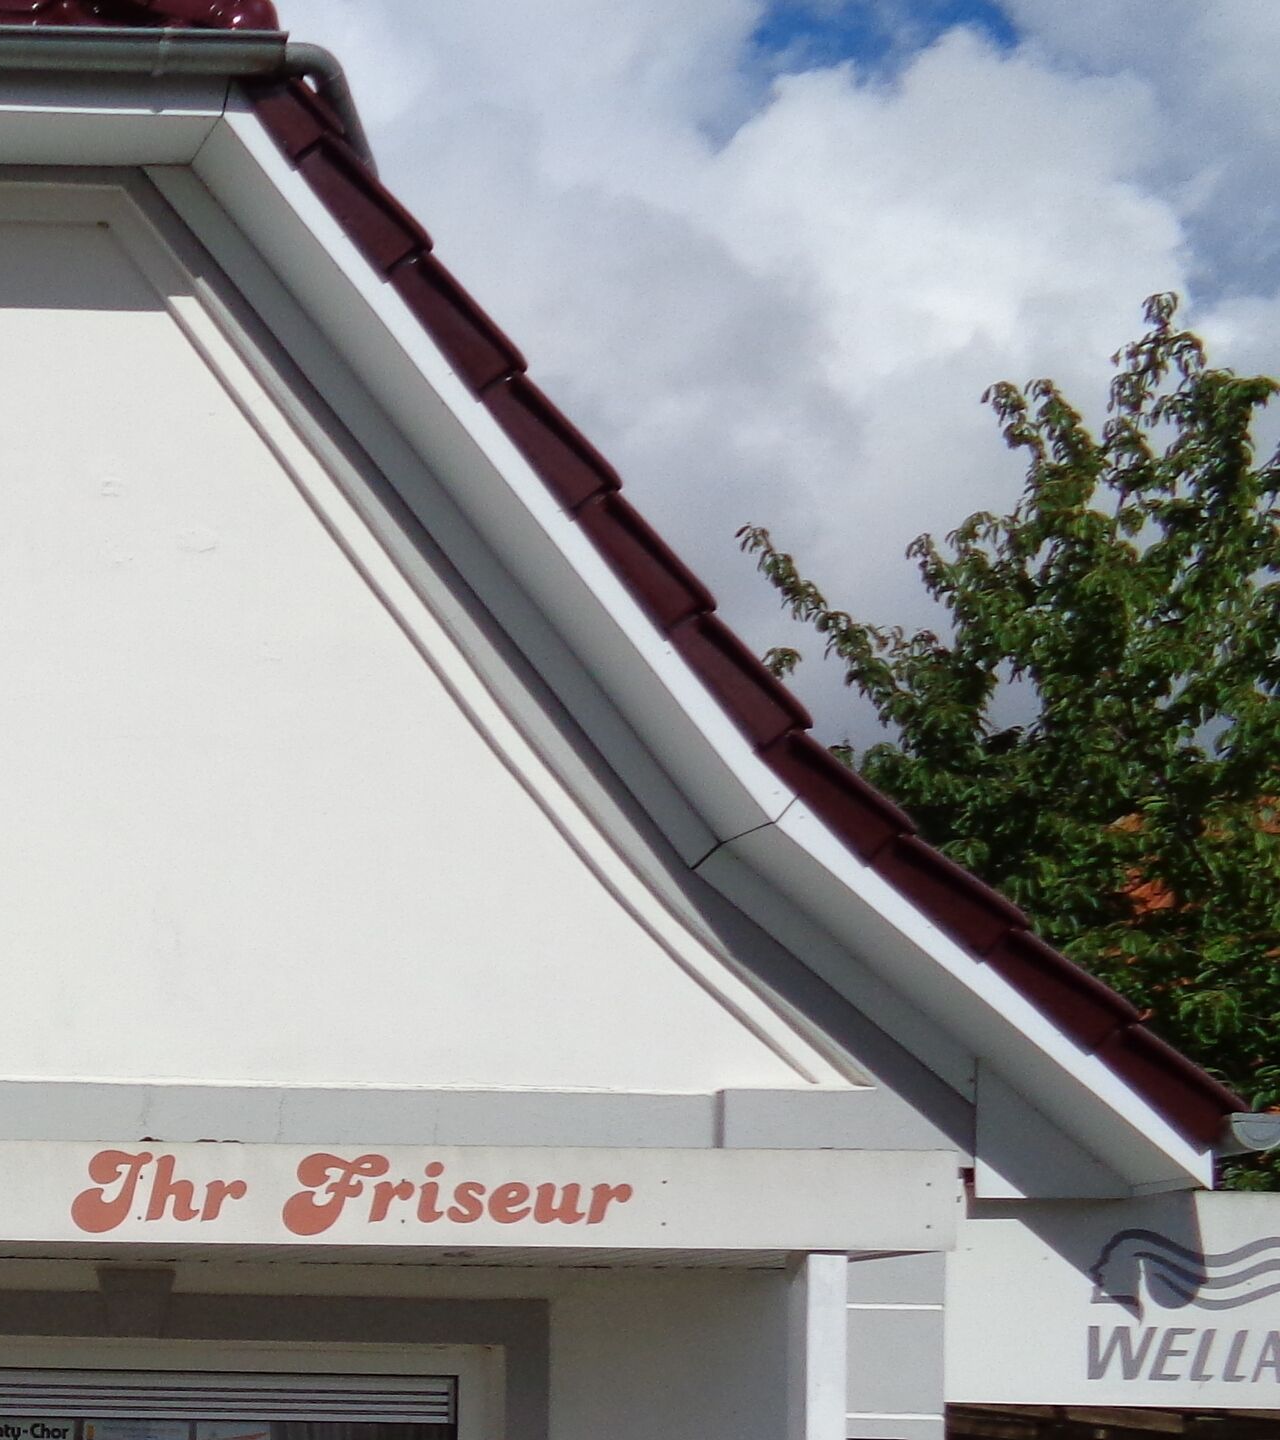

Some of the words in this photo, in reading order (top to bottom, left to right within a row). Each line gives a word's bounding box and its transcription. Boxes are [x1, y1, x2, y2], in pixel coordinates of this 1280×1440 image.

[71, 1149, 247, 1233] Ihr
[282, 1152, 632, 1236] Friseur
[1087, 1325, 1280, 1383] WELLA
